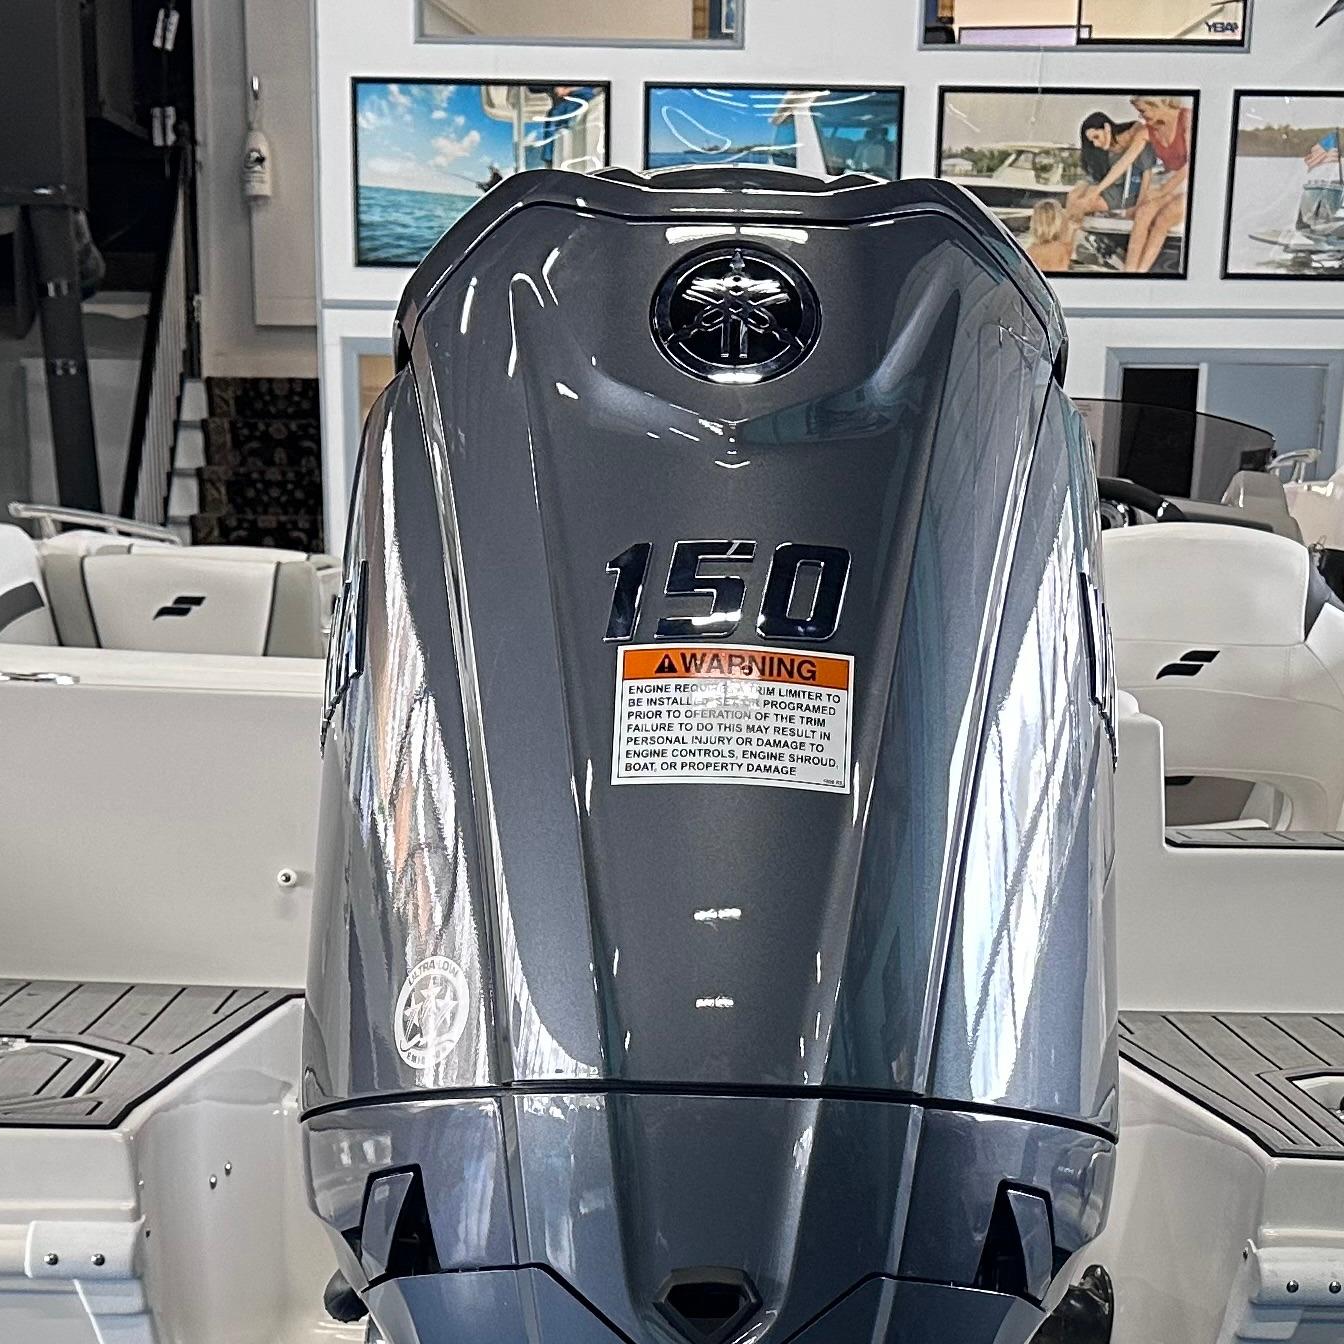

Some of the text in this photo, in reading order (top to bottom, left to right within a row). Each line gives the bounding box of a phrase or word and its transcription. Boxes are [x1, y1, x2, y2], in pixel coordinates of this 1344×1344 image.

[603, 539, 852, 642] 150
[680, 652, 817, 682] WARNING
[628, 683, 672, 695] ENGINE
[779, 687, 823, 702] LIMITER
[826, 693, 841, 704] TO
[628, 697, 643, 708] BE
[763, 699, 836, 716] PROGRAMED
[627, 710, 662, 720] PRIOR
[666, 709, 681, 719] TO
[754, 711, 770, 722] OF
[774, 713, 796, 724] THE
[799, 715, 826, 728] TRIM
[626, 722, 831, 741] FAILURE TO DO THIS MAY RESULT IN
[626, 735, 824, 753] PERSONAL INJURY OR DAMAGE TO
[624, 761, 797, 776] BOAT, OR PROPERTY DAMAGE
[625, 748, 839, 770] ENGINE CONTROLS, ENGINE SHROUD,
[408, 959, 436, 986] ULTRA
